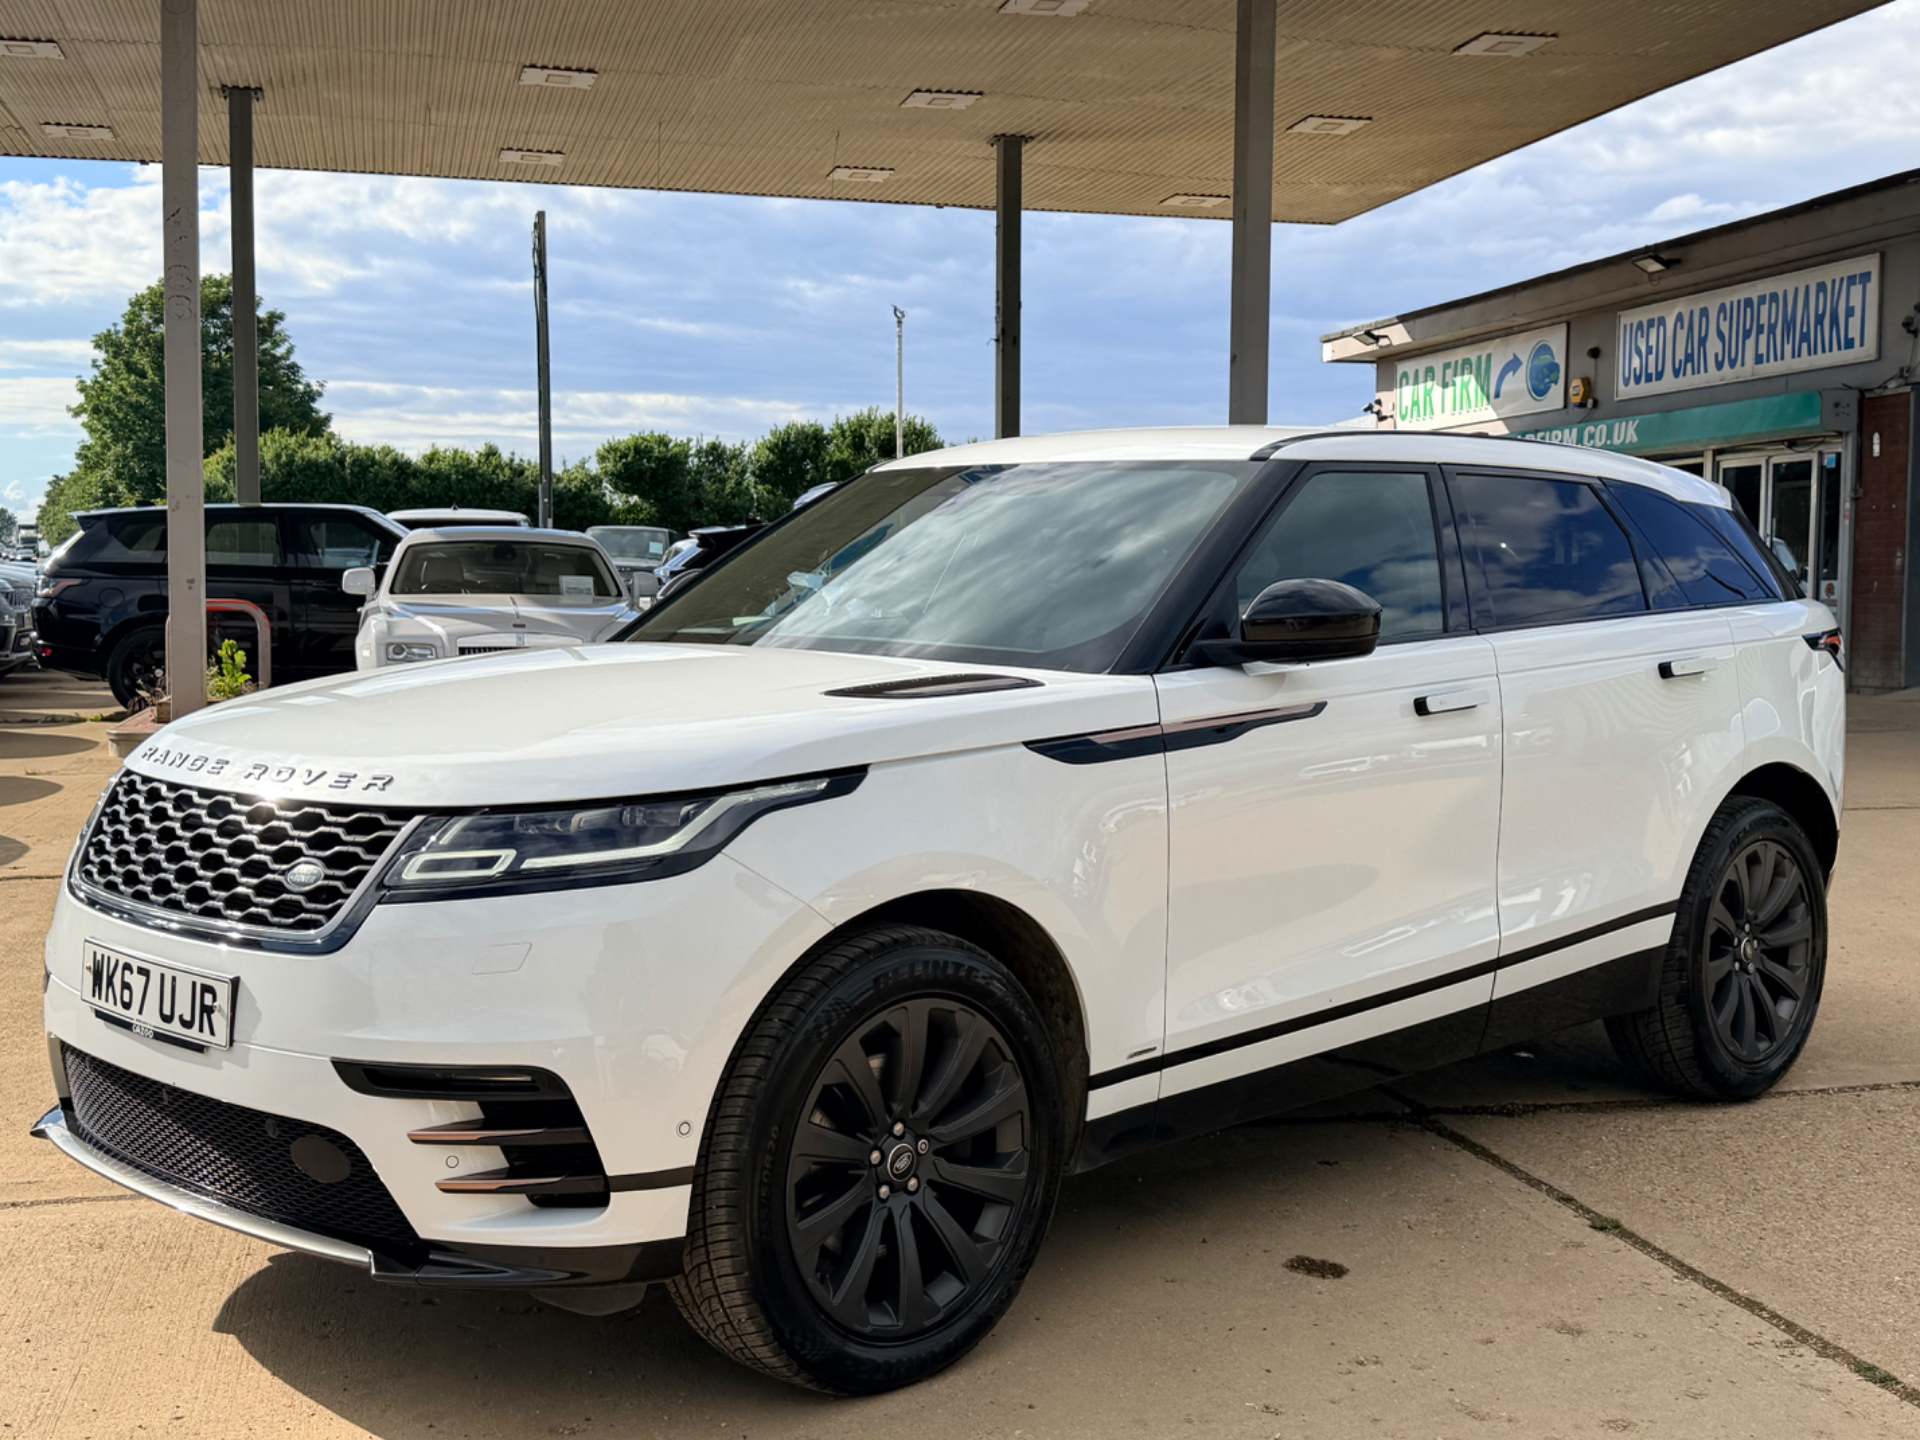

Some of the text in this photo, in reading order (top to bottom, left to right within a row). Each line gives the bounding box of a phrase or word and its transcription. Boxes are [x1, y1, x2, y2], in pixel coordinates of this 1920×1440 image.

[1622, 271, 1872, 387] USED CAR SUPERMARKET
[1399, 353, 1492, 421] CAR FIRM
[1517, 420, 1640, 448] FIRM.CO.UK
[141, 745, 394, 791] RANGE ROVER
[92, 951, 217, 1036] WK67 UJR
